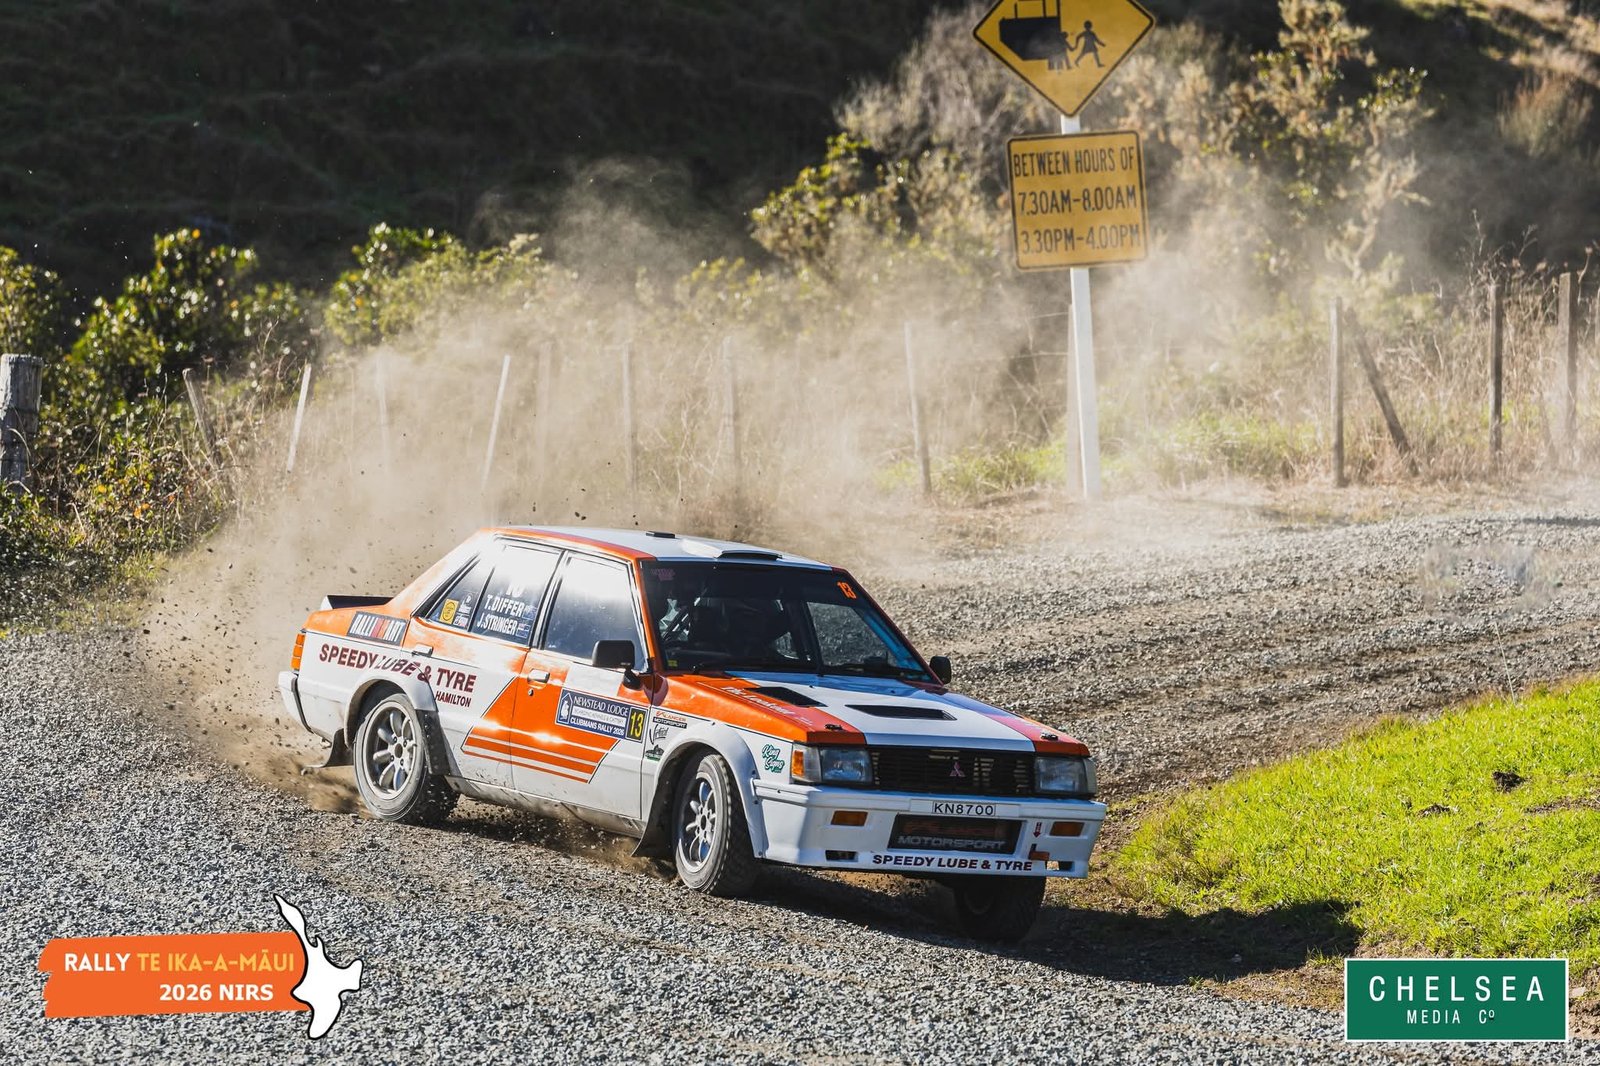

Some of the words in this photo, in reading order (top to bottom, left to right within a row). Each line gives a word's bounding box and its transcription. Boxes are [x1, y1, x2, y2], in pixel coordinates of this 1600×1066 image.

[1013, 150, 1070, 177] BETWEEN
[1075, 148, 1115, 173] HOURS
[1120, 146, 1134, 171] OF
[1018, 185, 1137, 216] 7.30AM-8.00AM
[484, 594, 525, 618] T.DIFFER
[477, 612, 518, 636] J.STRINGER
[319, 643, 378, 669] SPEEDY
[375, 655, 421, 677] LUBE
[417, 665, 433, 684] &
[436, 668, 477, 693] TYRE
[435, 690, 472, 708] HAMILTON
[573, 696, 606, 711] NEWSTEAD
[607, 704, 629, 717] LODGE
[570, 717, 597, 730] CLUBMANS
[597, 724, 613, 733] RALLY
[630, 712, 643, 738] 13
[934, 803, 993, 815] KN8700
[897, 835, 1006, 850] MOTORSPORT
[872, 854, 935, 868] SPEEDY
[938, 857, 978, 869] LUBE
[981, 860, 991, 870] &
[995, 860, 1032, 871] TYRE
